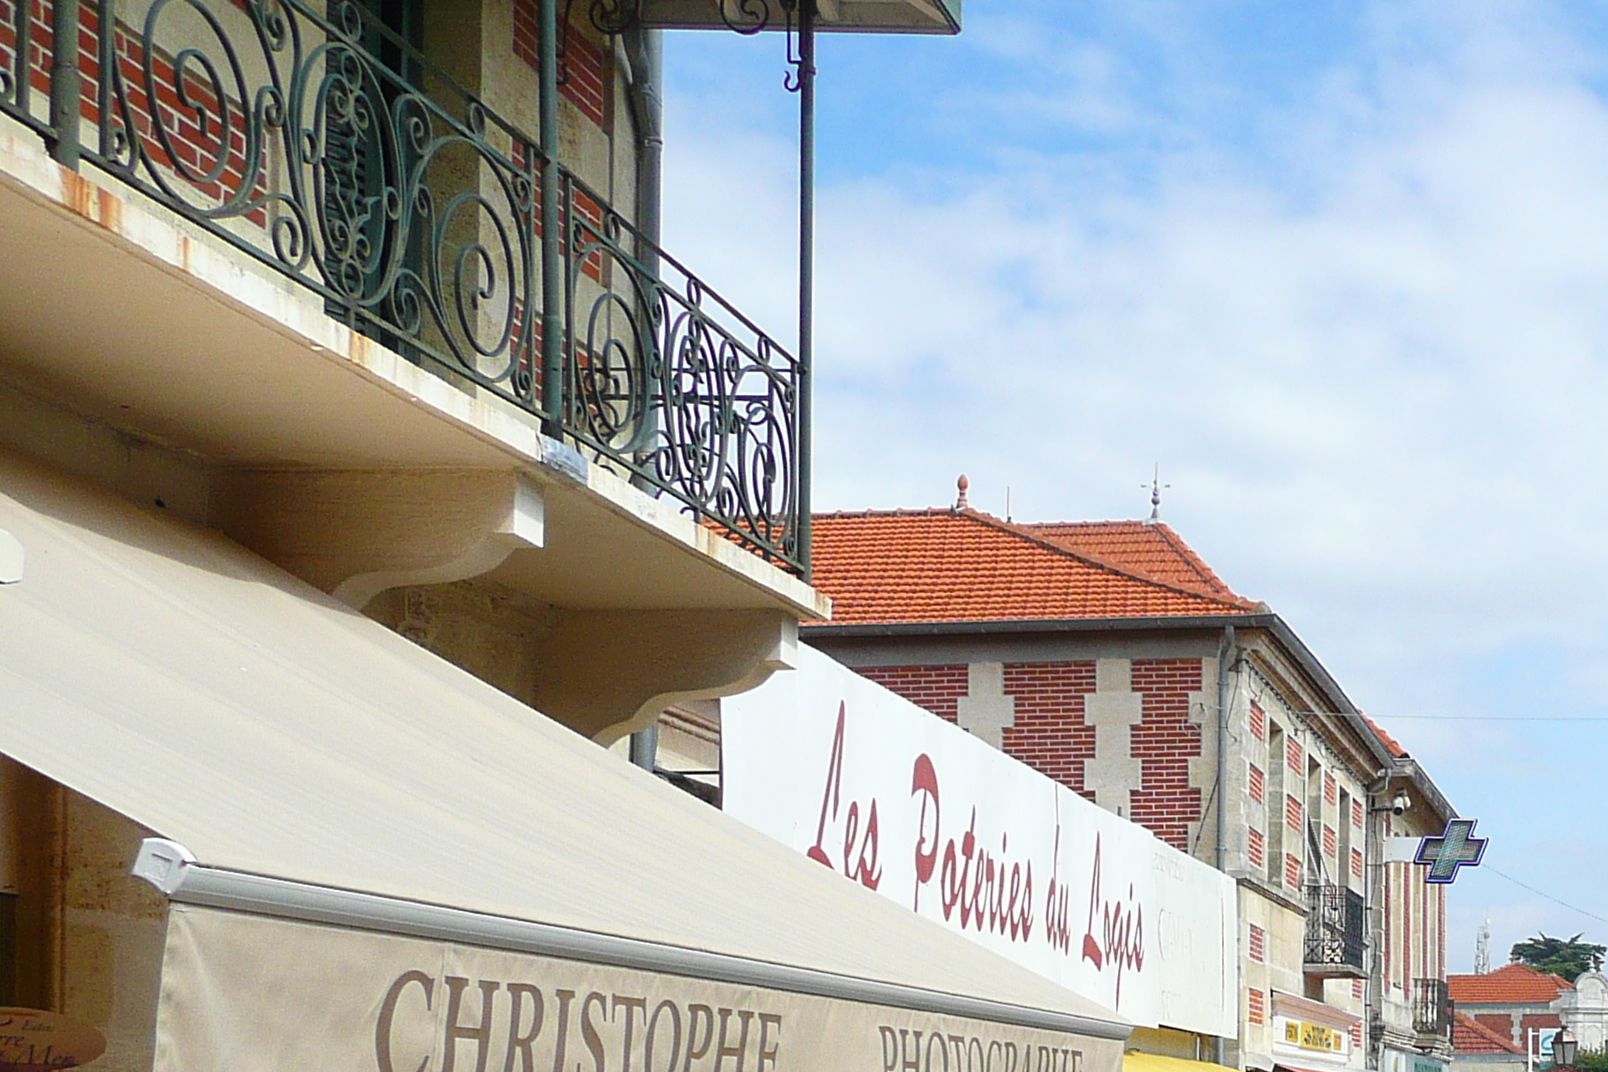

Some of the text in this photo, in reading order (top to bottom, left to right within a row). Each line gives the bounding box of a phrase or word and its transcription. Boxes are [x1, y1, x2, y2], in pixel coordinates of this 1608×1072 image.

[805, 699, 1145, 1012] Les Poteries du Logis
